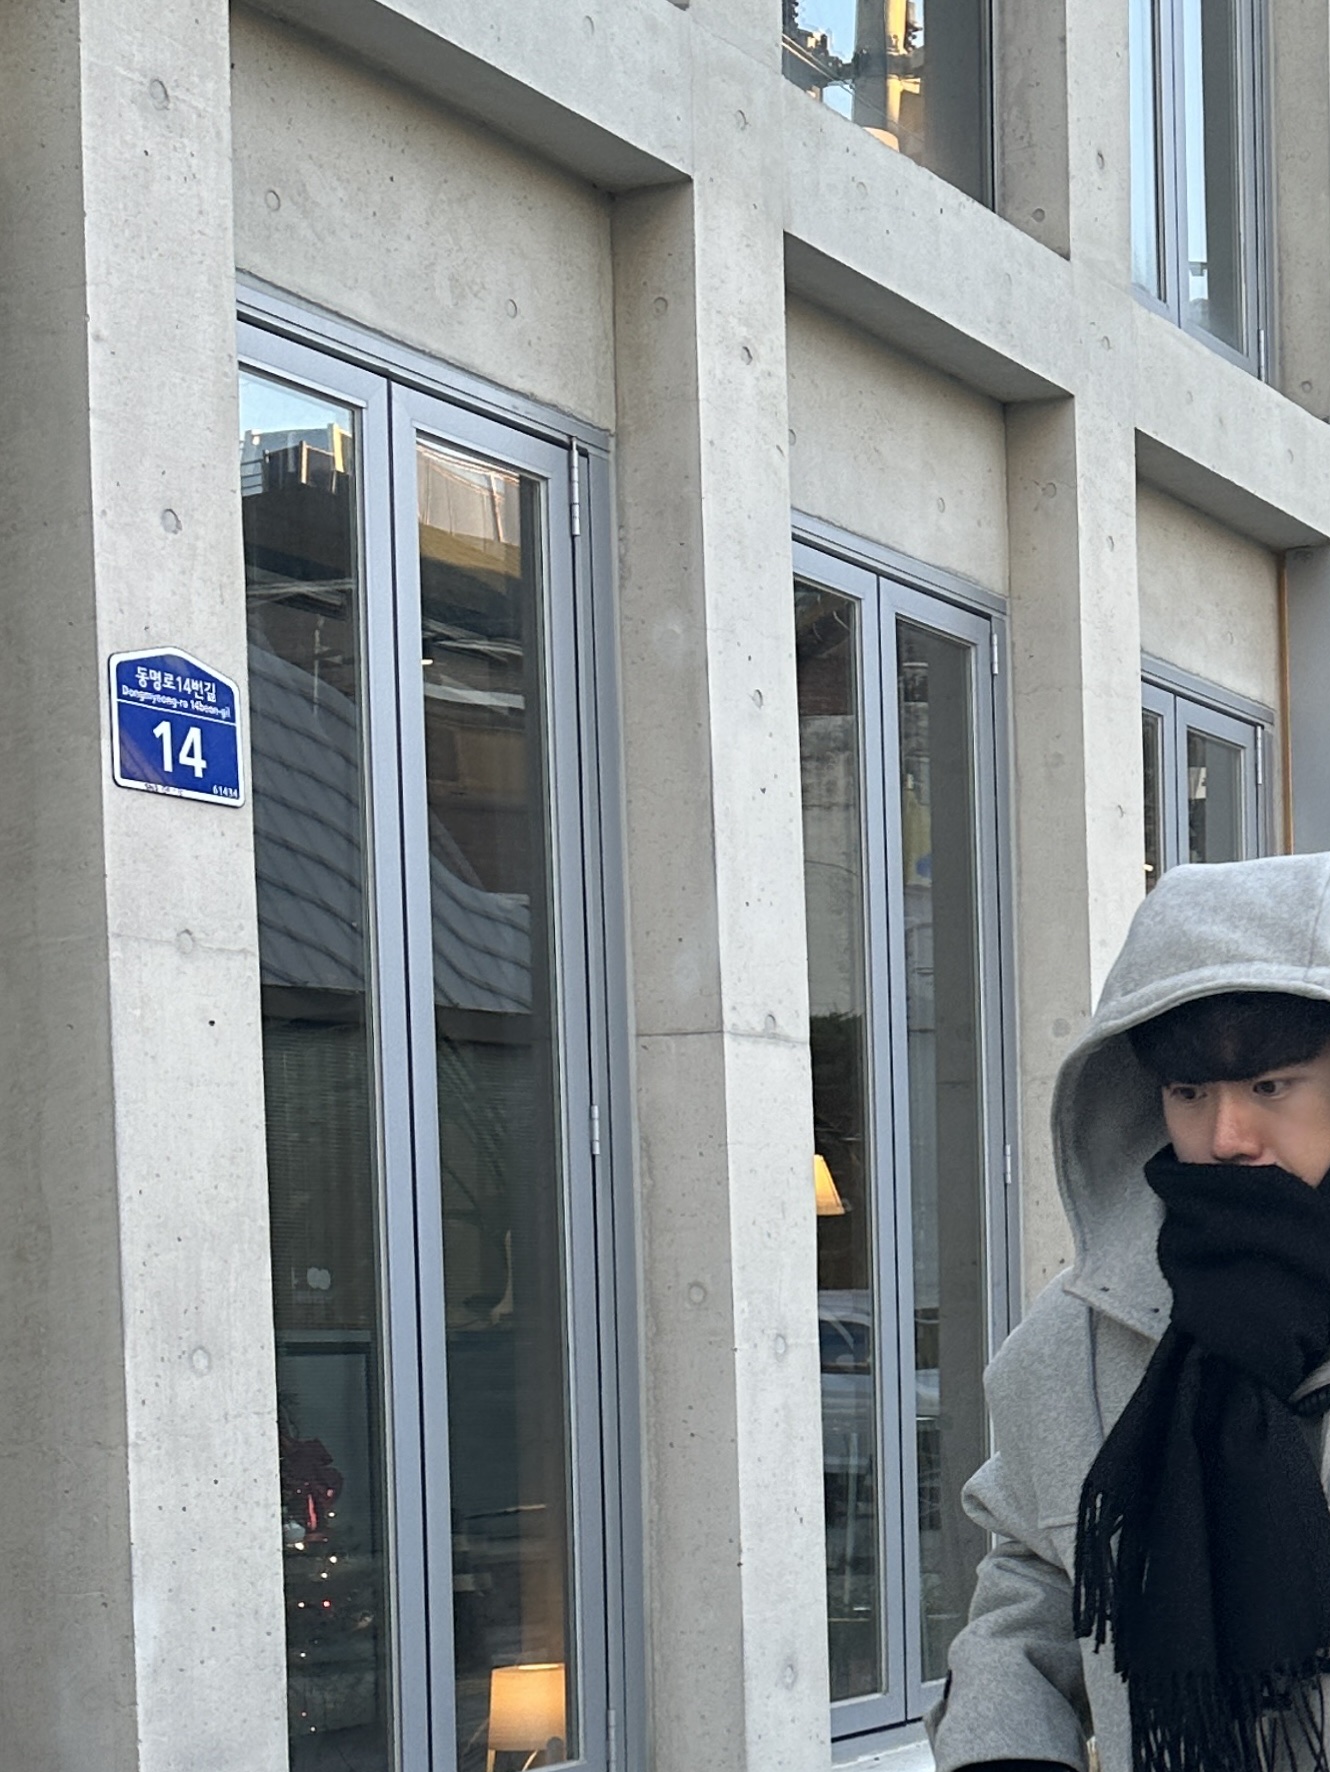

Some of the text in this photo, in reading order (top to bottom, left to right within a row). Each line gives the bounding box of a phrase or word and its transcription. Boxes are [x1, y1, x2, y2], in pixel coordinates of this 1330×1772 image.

[121, 684, 188, 708] Dongmyeong-ro
[135, 666, 217, 702] 동명로14번길
[152, 720, 207, 778] 14
[212, 784, 239, 798] 61434
